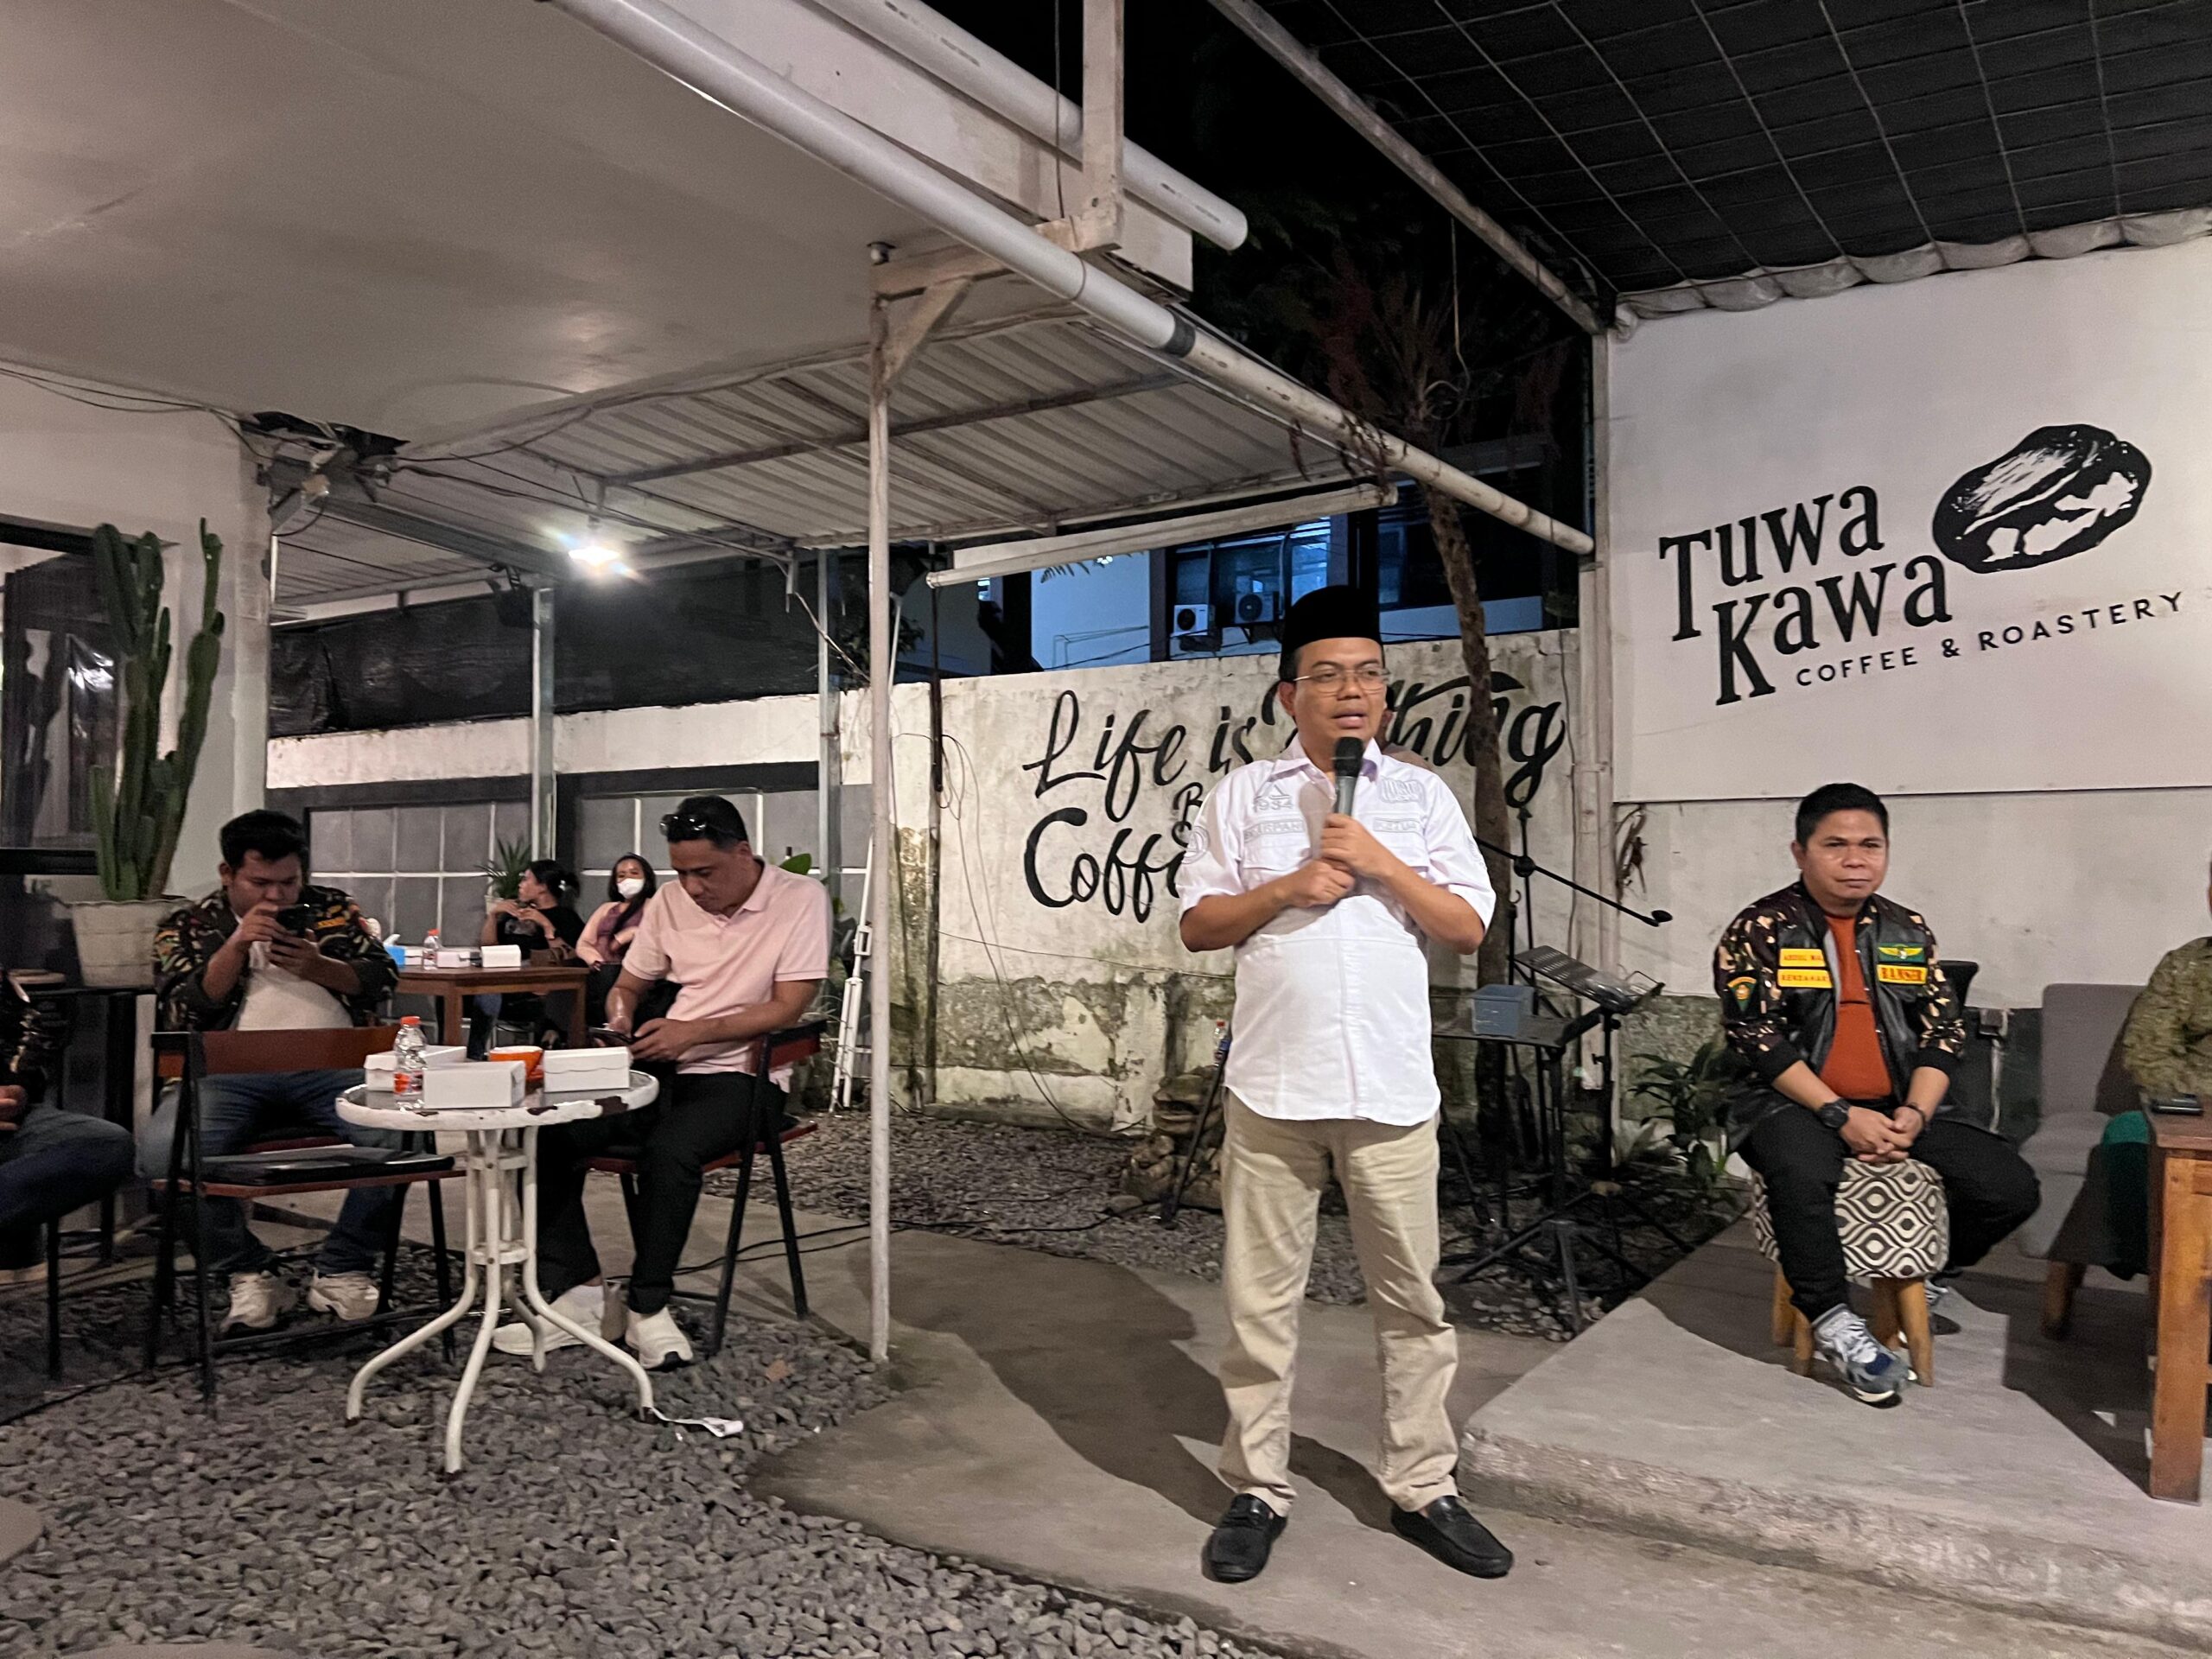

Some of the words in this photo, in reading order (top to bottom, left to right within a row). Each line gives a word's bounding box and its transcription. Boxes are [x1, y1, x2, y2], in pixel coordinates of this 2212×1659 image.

[1658, 485, 1885, 642] Tuwa
[1712, 555, 1953, 706] Kawa
[1795, 646, 1919, 687] COFFEE
[1940, 638, 1961, 658] &
[1977, 591, 2182, 652] ROASTERY
[1022, 690, 1188, 823] Life
[1209, 705, 1257, 775] is
